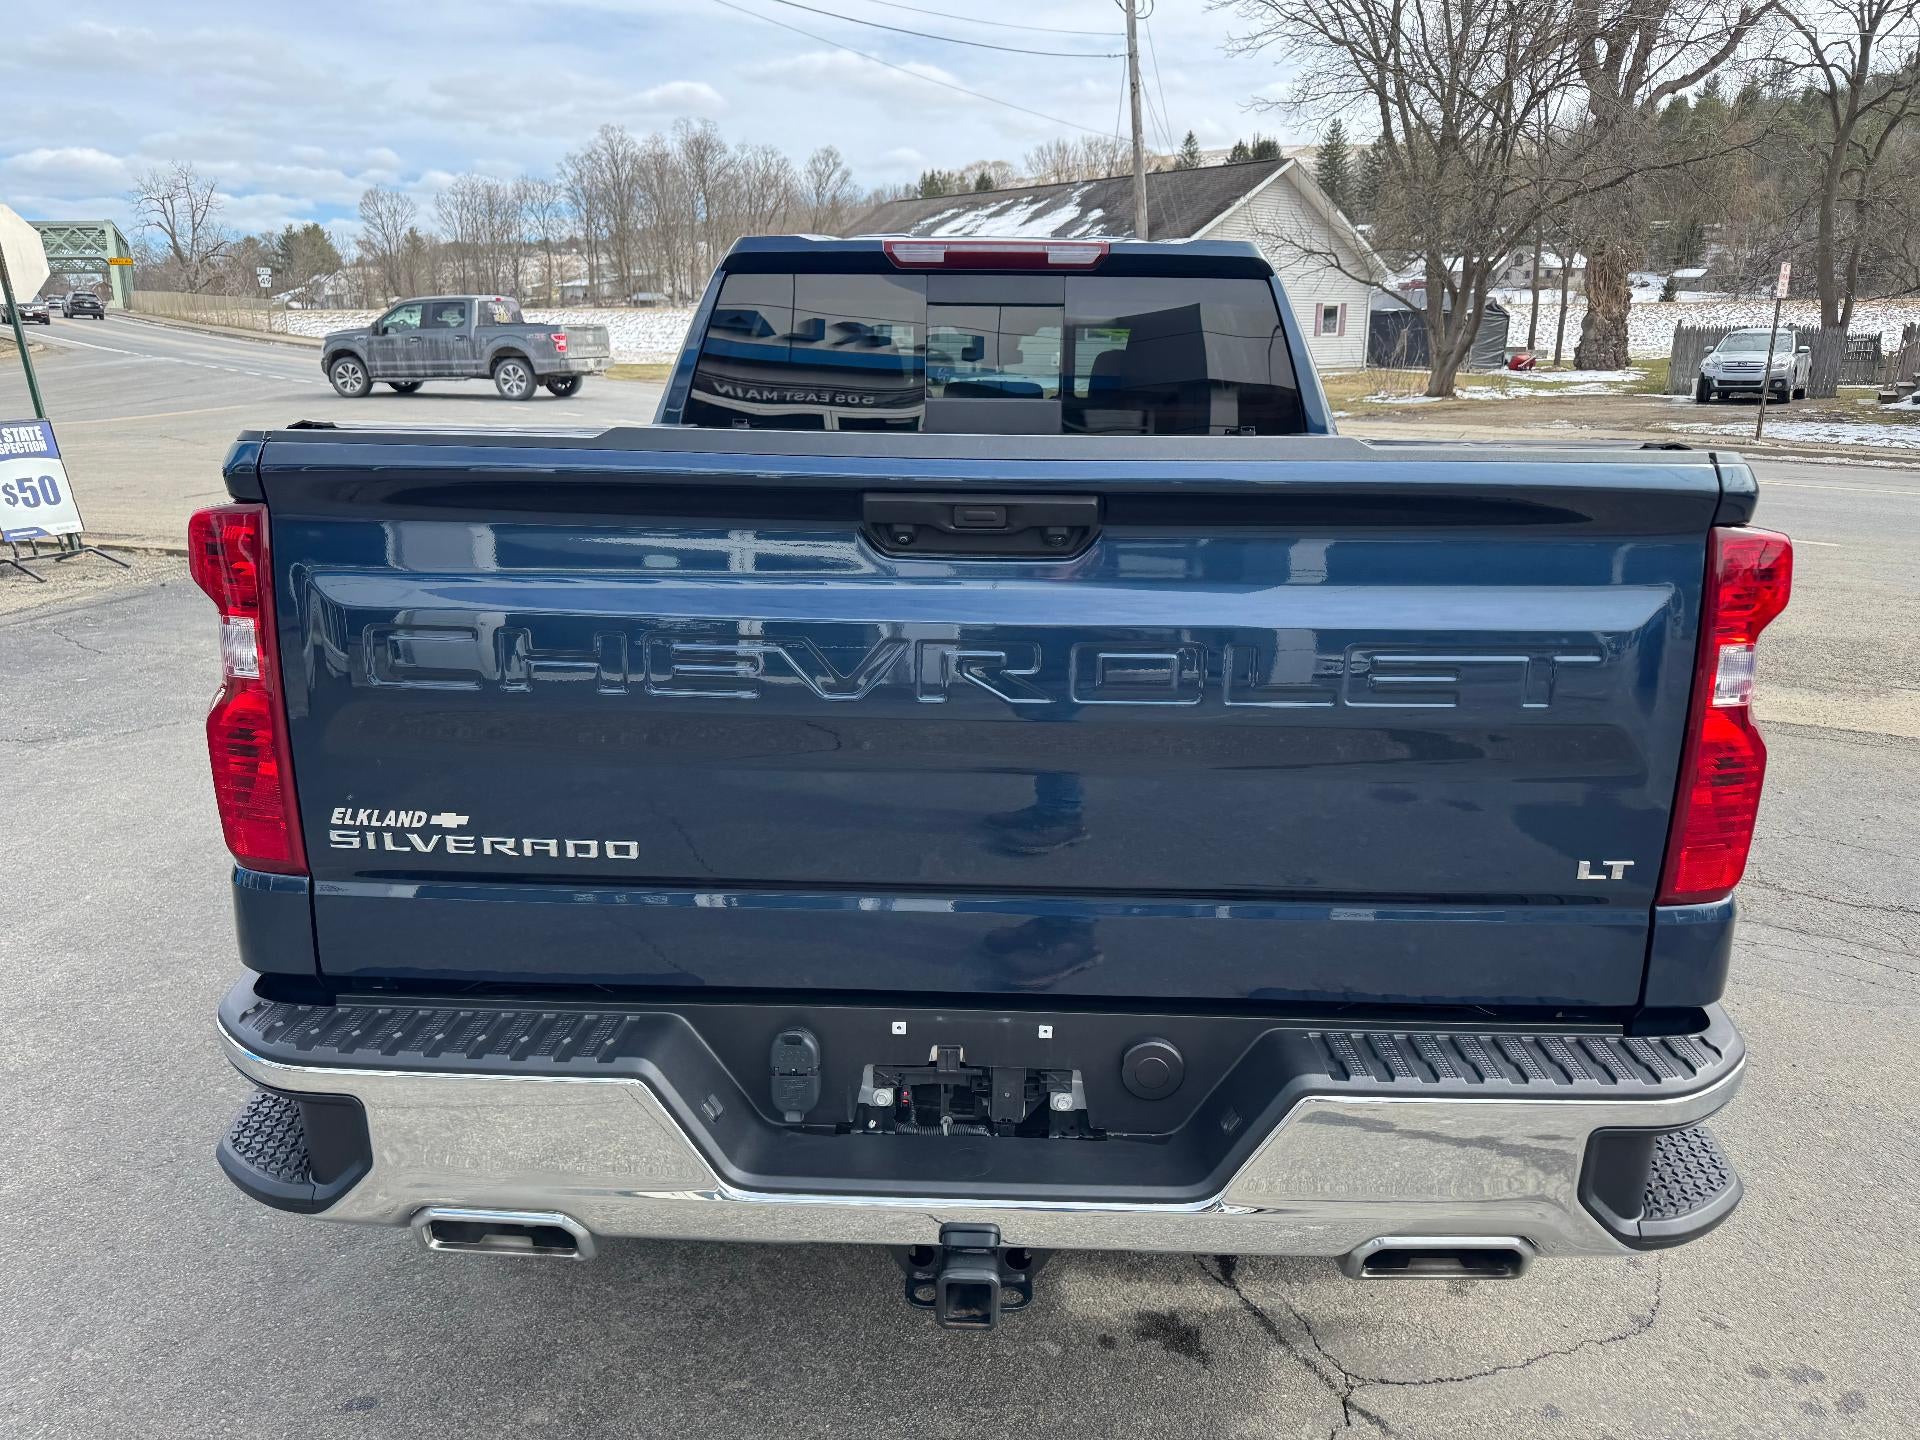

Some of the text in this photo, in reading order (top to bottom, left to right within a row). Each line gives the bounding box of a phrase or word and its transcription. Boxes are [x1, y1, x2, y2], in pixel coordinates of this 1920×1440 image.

[1, 425, 45, 443] STATE
[2, 475, 61, 508] $50
[361, 622, 1607, 709] CHEVROLET
[331, 807, 428, 828] ELKLAND
[329, 829, 640, 860] SILVERADO
[1576, 860, 1635, 880] LT
